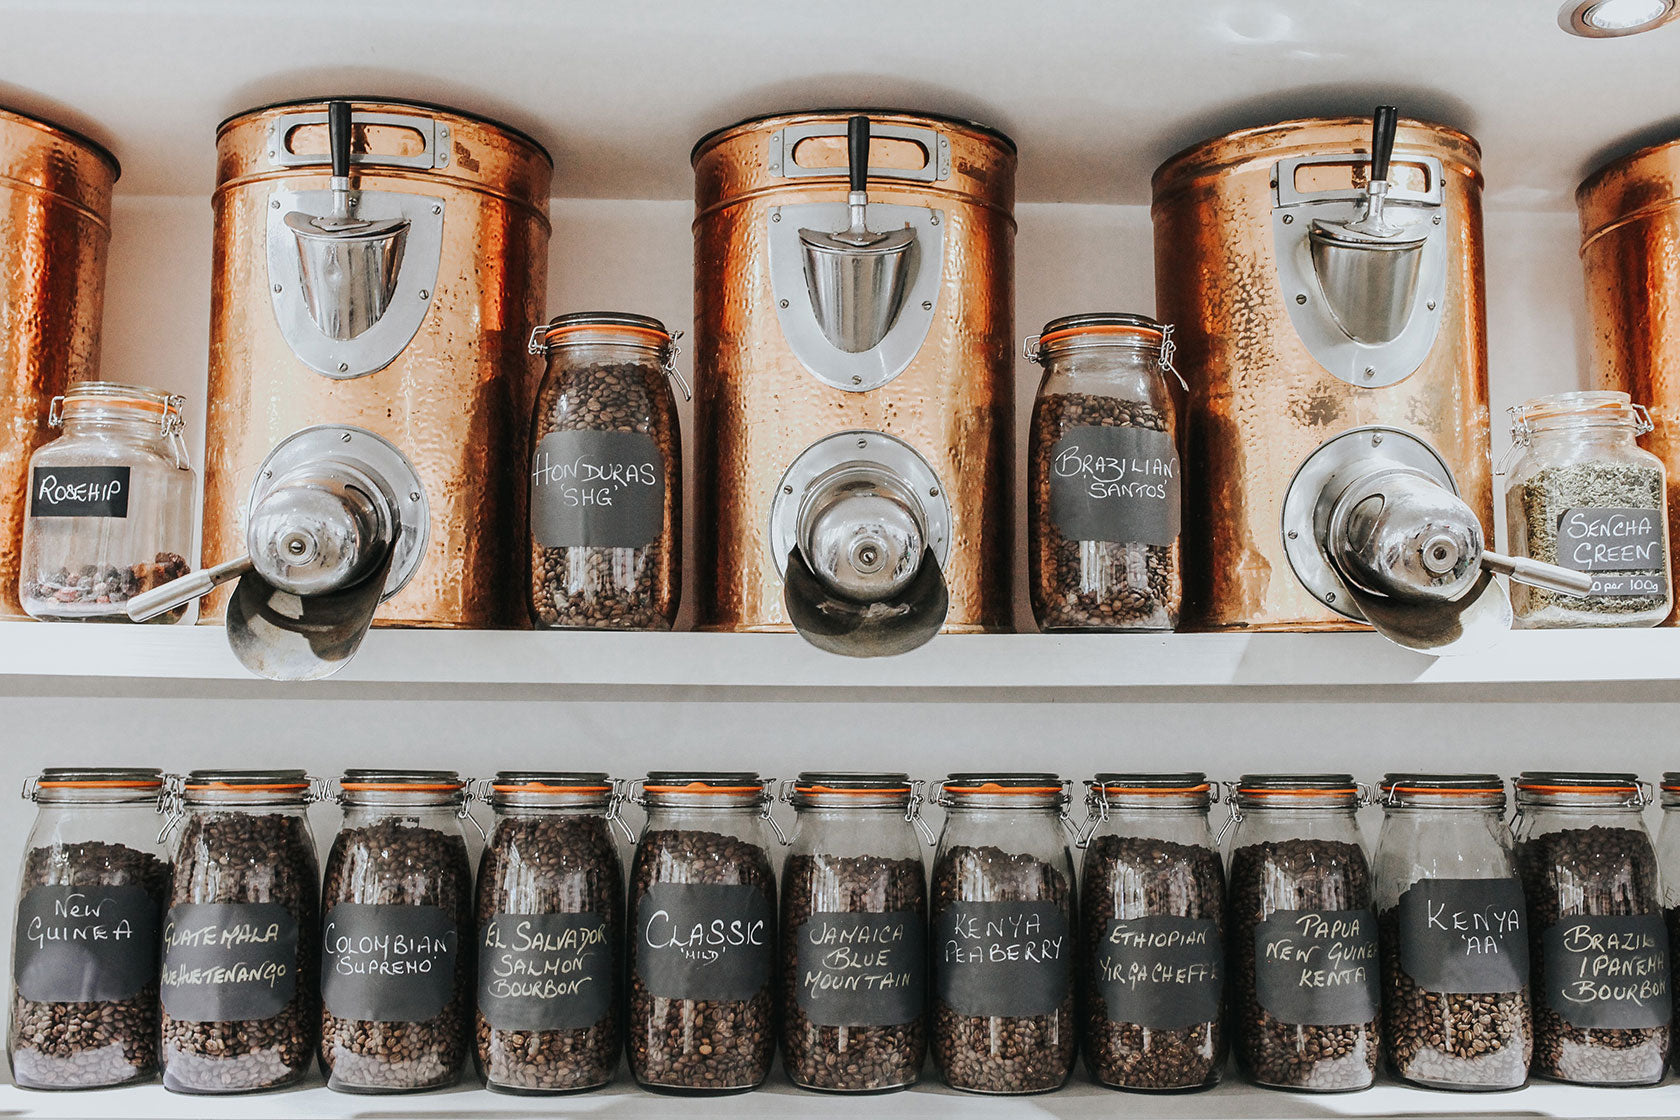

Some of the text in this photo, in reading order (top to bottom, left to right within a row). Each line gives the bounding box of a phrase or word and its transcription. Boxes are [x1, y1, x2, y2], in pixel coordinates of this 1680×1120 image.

[532, 452, 656, 487] HONDURAS
[1055, 445, 1177, 483] BRAZILIAN
[38, 474, 122, 505] ROSEHIP
[1567, 513, 1652, 539] SENCHA
[1573, 542, 1660, 570] GREEN
[1604, 582, 1624, 593] per
[1630, 579, 1659, 594] 100g
[645, 910, 764, 949] CLASSIC
[954, 913, 1041, 939] KENYA
[1296, 914, 1360, 939] PAPUA
[1428, 899, 1519, 933] KENYA
[27, 916, 133, 949] GUINEA
[164, 922, 279, 954] GUATEMALA
[324, 922, 456, 960] COLOMBIAN
[485, 921, 608, 954] EL SALVADOR
[809, 922, 904, 945] JAMAICA
[1109, 925, 1207, 948] ETHIOPIAN
[1563, 924, 1656, 953] BRAZIL
[822, 947, 892, 970] BLUE
[945, 936, 1063, 964] PEABERRY
[1266, 939, 1320, 963] NEW
[493, 952, 585, 977] SALMON
[1298, 967, 1366, 988] KENTA
[487, 976, 592, 999] BOURBON
[804, 969, 911, 999] MOUNTAIN
[1562, 979, 1667, 1007] BOURBON
